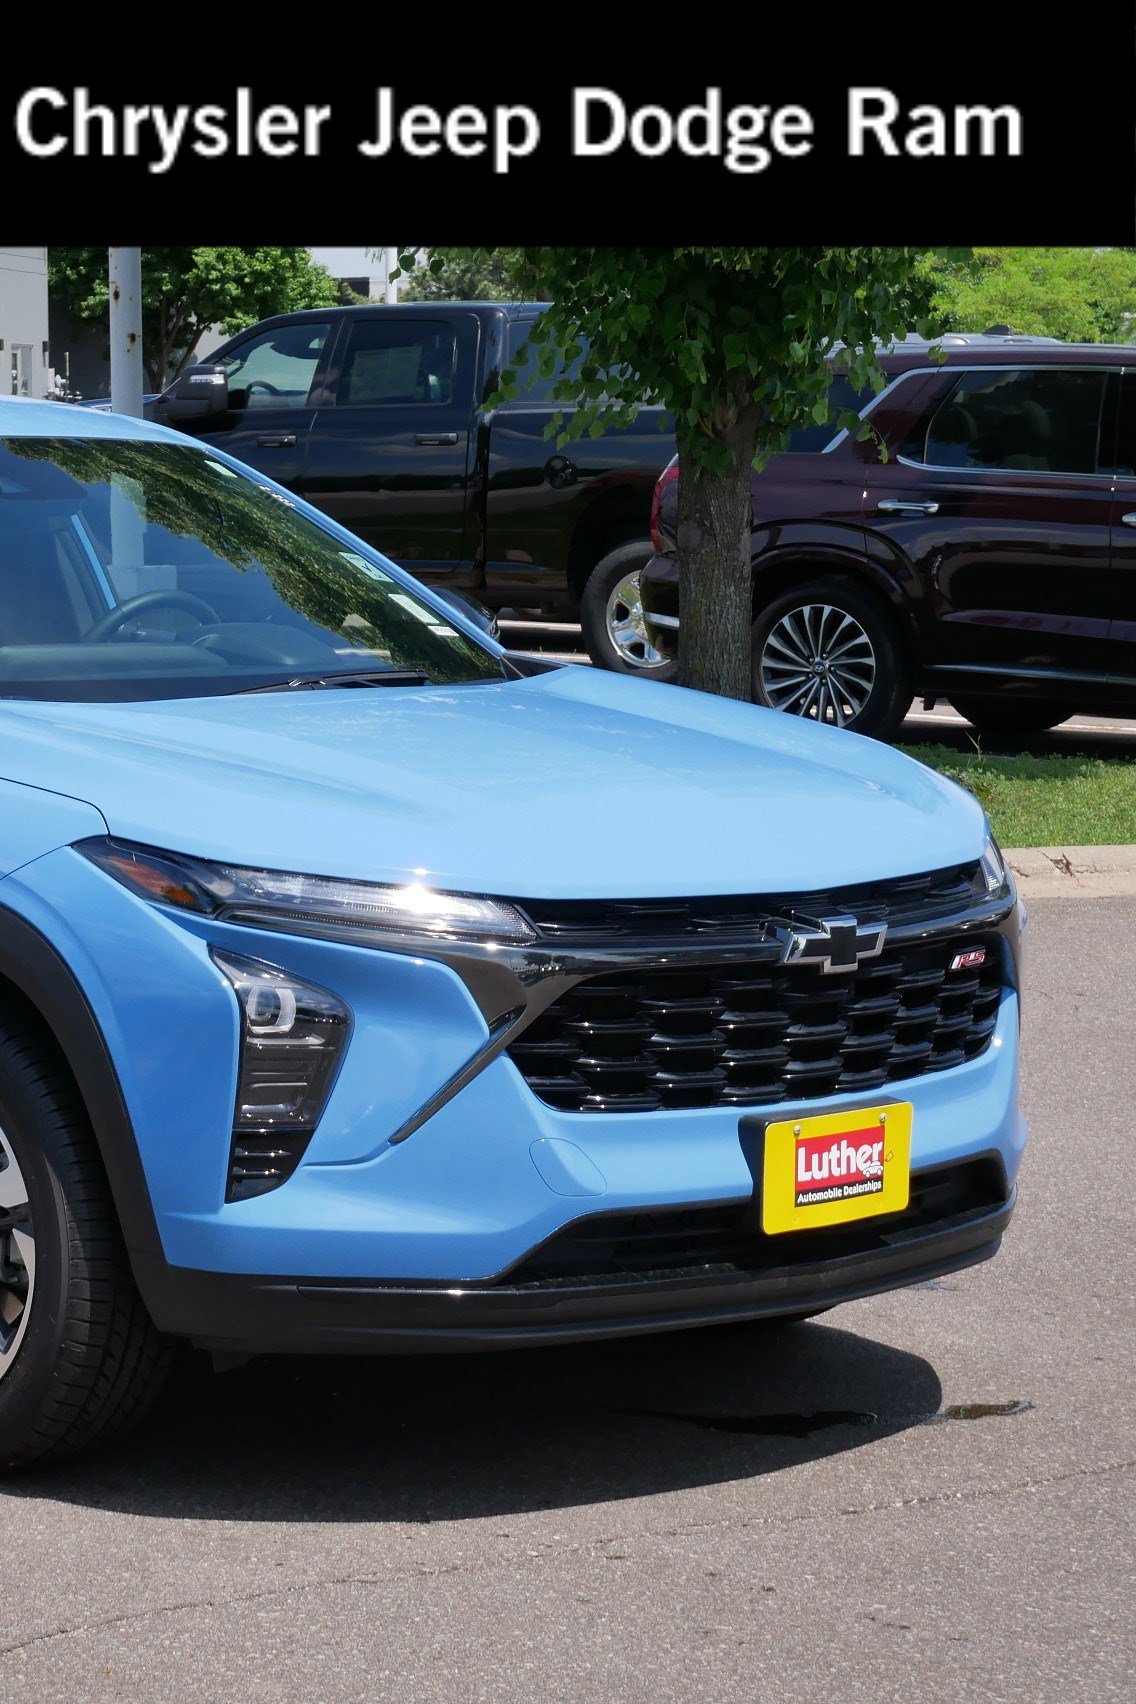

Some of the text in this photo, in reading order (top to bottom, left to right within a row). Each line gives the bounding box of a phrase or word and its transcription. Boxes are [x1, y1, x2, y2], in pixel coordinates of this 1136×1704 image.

[955, 950, 986, 969] RS
[797, 1139, 883, 1182] Luther
[797, 1180, 882, 1204] Automobile Dealerships
